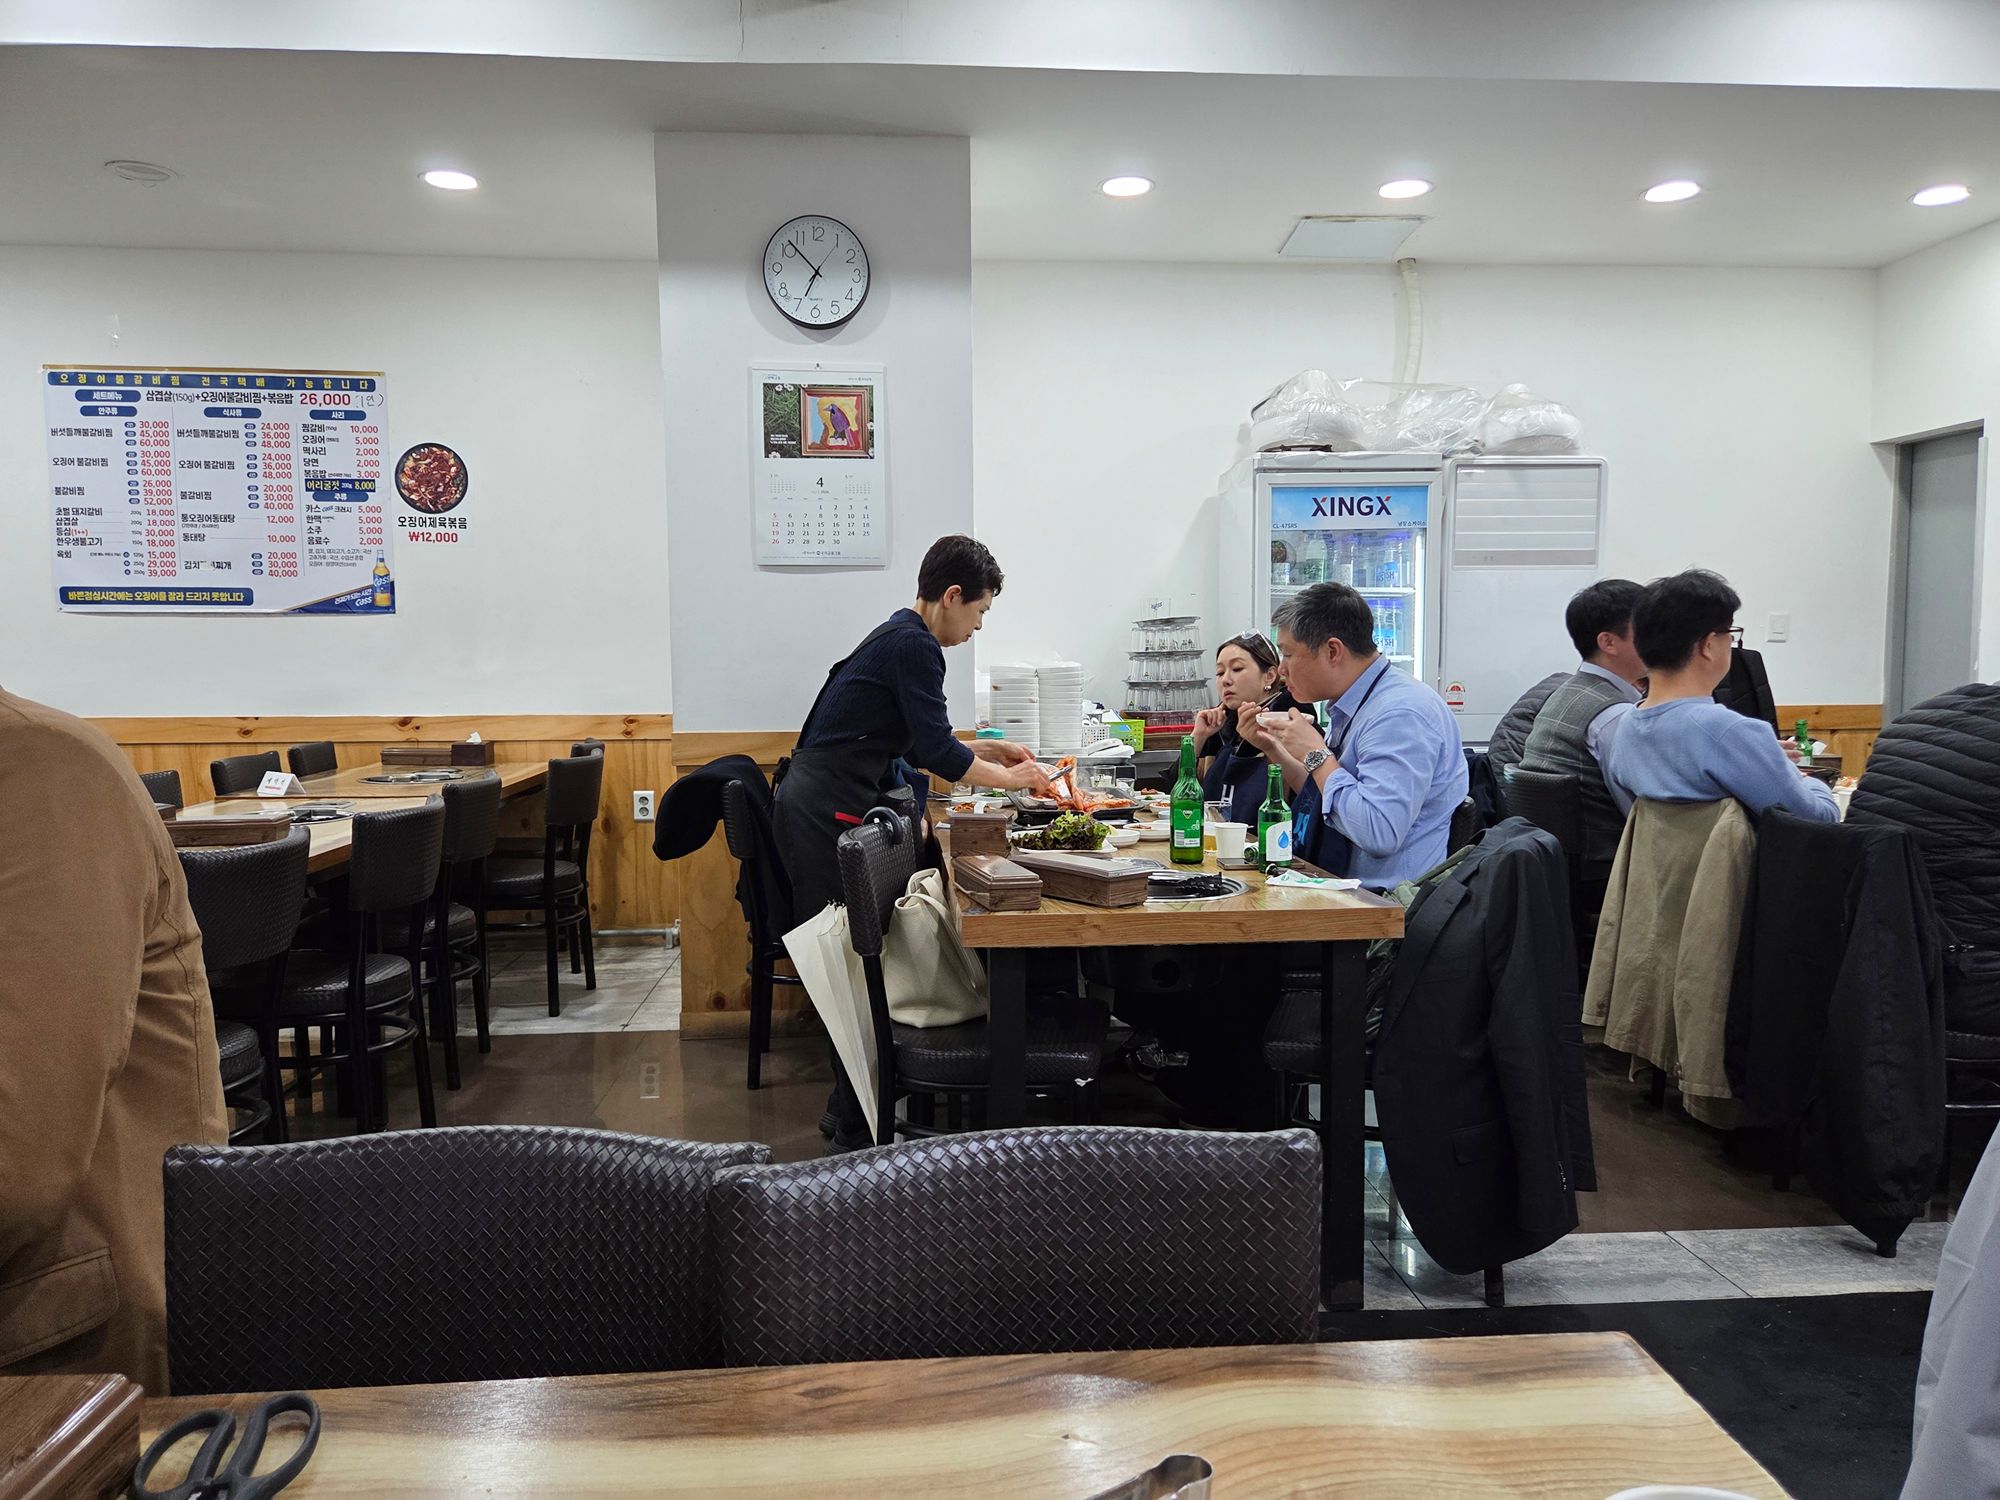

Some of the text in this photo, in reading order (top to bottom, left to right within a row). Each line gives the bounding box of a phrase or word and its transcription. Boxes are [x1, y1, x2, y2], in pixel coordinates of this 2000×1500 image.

[796, 231, 804, 245] 11
[812, 226, 824, 241] 12
[782, 243, 796, 258] 10
[846, 249, 855, 264] 2
[772, 262, 782, 276] 9
[852, 268, 861, 283] 3
[779, 282, 788, 297] 8
[845, 288, 853, 302] 4
[794, 298, 802, 312] 7
[830, 301, 840, 315] 5
[811, 304, 820, 318] 6
[287, 377, 368, 390] 가능합니다
[92, 391, 122, 400] 세트메뉴
[300, 393, 351, 407] 26,000
[98, 407, 118, 416] 안주류
[222, 409, 243, 417] 식사류
[331, 411, 345, 420] 사리
[139, 421, 169, 430] 30,000
[260, 422, 289, 431] 24,000
[302, 424, 325, 433] 찜갈비
[350, 426, 378, 434] 10,000
[139, 430, 169, 440] 45,000
[261, 432, 290, 440] 36,000
[140, 439, 170, 448] 60,000
[261, 440, 290, 449] 48,000
[302, 436, 325, 444] 오징어
[355, 437, 378, 445] 5,000
[140, 451, 170, 460] 30,000
[303, 446, 379, 457] 떡사리 2,000
[52, 458, 109, 467] 오징어 불갈비찜
[262, 454, 291, 462] 24,000
[141, 460, 171, 469] 45,000
[178, 460, 235, 470] 오징어 불갈비찜
[262, 463, 291, 471] 36,000
[303, 458, 379, 468] 당면 2,000
[141, 468, 171, 478] 60,000
[262, 472, 292, 480] 48,000
[304, 470, 326, 478] 볶음밥
[357, 471, 380, 479] 3,000
[143, 480, 172, 489] 26,000
[307, 480, 339, 490] 어리굴젓
[816, 477, 824, 487] 4
[55, 487, 85, 496] 불갈비찜
[143, 489, 172, 498] 39,000
[263, 485, 293, 494] 20,000
[180, 491, 212, 500] 불갈비찜
[264, 494, 293, 502] 30,000
[144, 498, 173, 507] 52,000
[264, 502, 293, 512] 40,000
[1311, 496, 1392, 517] XINGX
[56, 508, 70, 516] 초벌
[71, 507, 102, 516] 돼지갈비
[146, 509, 175, 518] 18,000
[358, 506, 381, 514] 5,000
[56, 517, 78, 526] 삼겹살
[147, 519, 176, 528] 18,000
[267, 516, 294, 524] 12,000
[306, 515, 322, 524] 한맥
[358, 516, 382, 524] 5,000
[398, 516, 467, 529] 오징어제육볶음
[145, 529, 174, 538] 30,000
[307, 526, 382, 535] 소주 5,000
[183, 533, 296, 544] 동태탕 10,000
[308, 537, 382, 546] 음료수 2,000
[147, 539, 175, 548] 18,000
[57, 550, 72, 558] 육회
[147, 552, 176, 560] 15,000
[268, 552, 297, 560] 20,000
[148, 561, 176, 569] 29,000
[184, 561, 232, 570] 김치찌개
[268, 561, 297, 569] 30,000
[148, 569, 176, 578] 39,000
[268, 570, 298, 578] 40,000
[135, 592, 166, 601] 오징어를
[186, 592, 210, 601] 드리지
[212, 592, 244, 602] 못합니다
